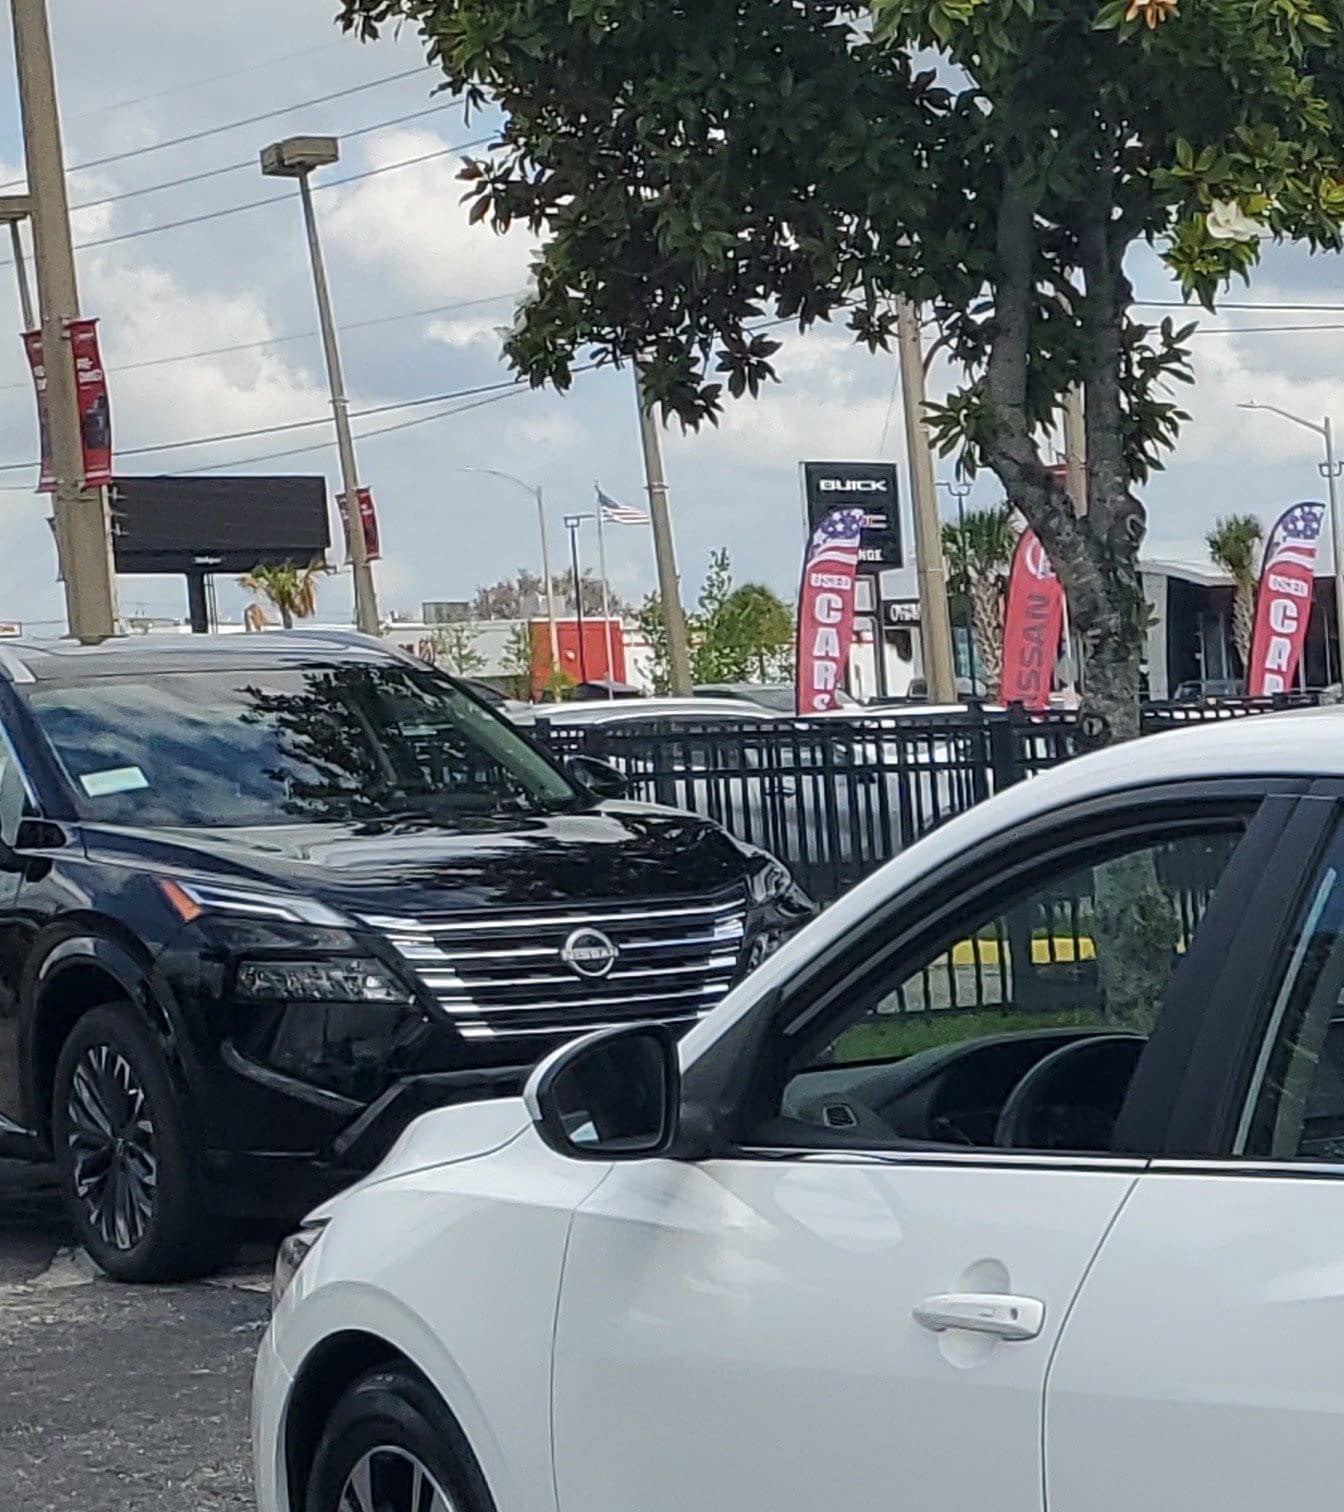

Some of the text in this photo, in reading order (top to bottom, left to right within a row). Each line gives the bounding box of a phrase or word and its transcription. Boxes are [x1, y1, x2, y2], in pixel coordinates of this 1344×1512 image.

[819, 479, 888, 492] BUICK
[1016, 592, 1050, 701] ISSAN
[1262, 598, 1299, 697] CAR
